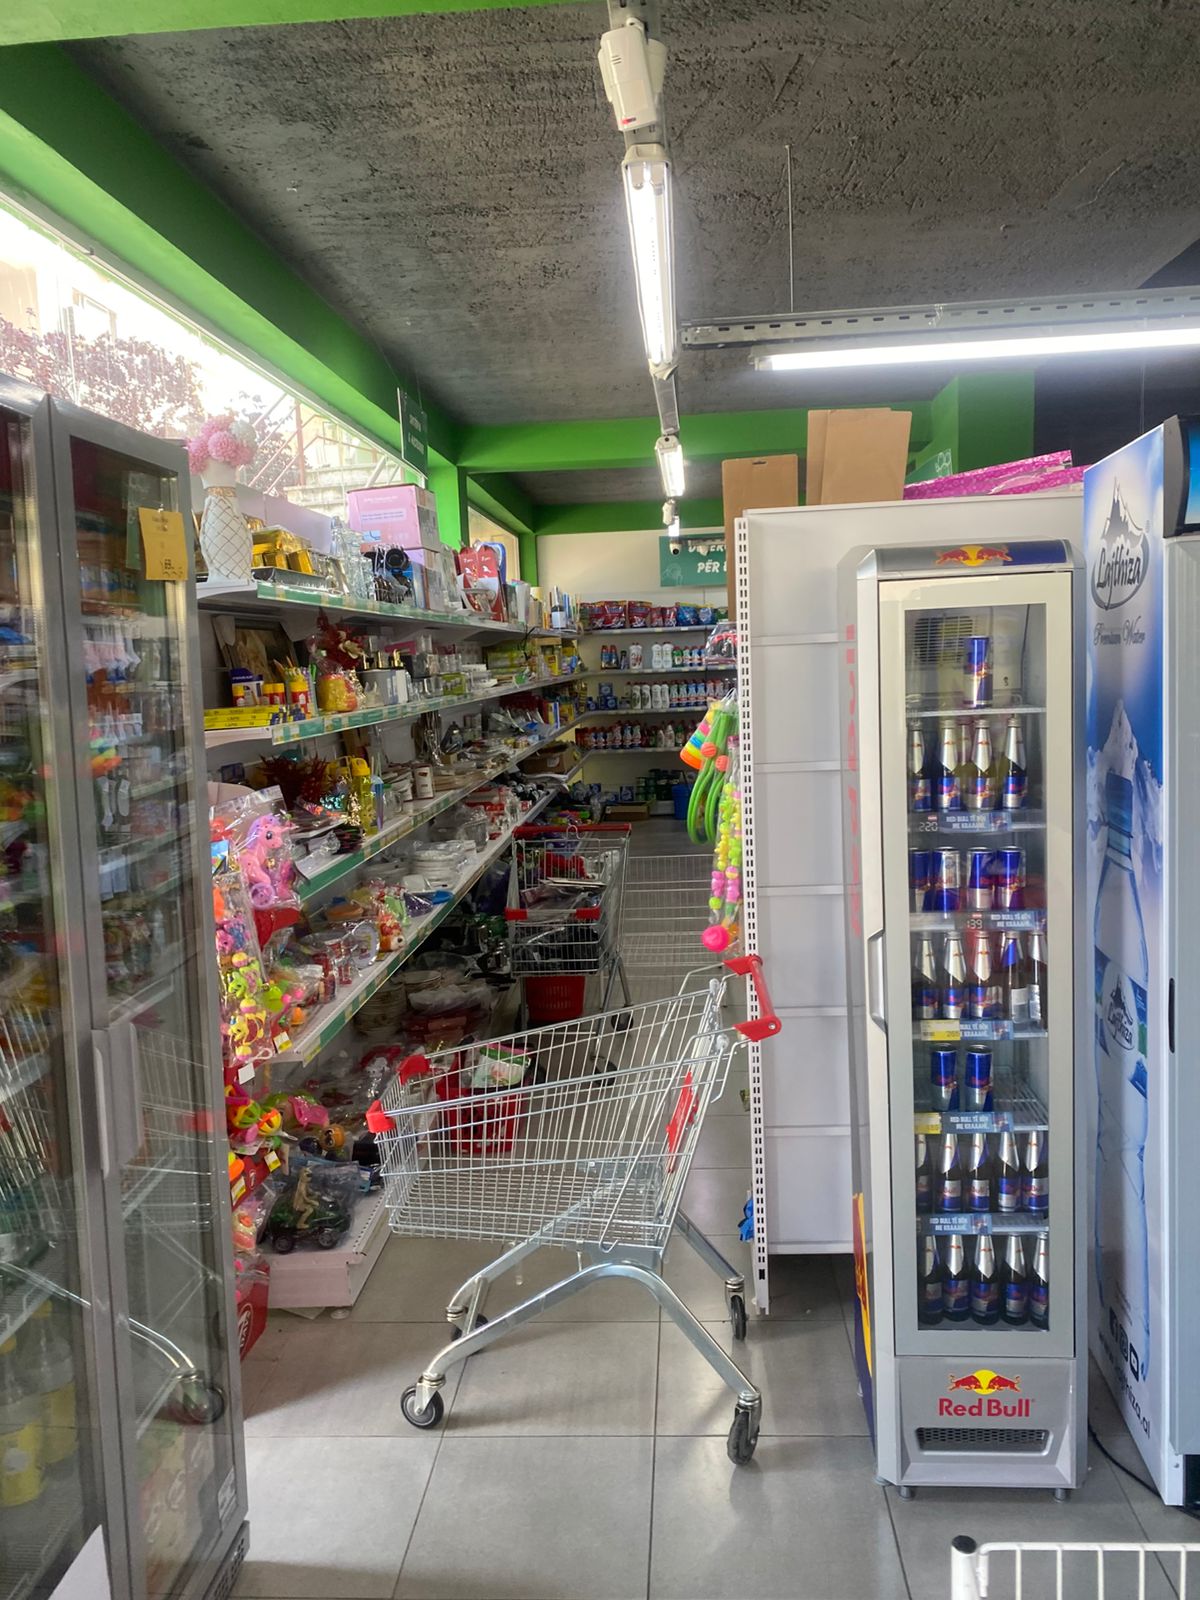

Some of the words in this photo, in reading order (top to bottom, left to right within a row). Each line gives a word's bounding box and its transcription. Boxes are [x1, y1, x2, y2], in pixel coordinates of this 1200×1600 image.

[697, 559, 720, 573] PËR
[939, 1398, 983, 1417] Red
[987, 1398, 1030, 1417] Bull
